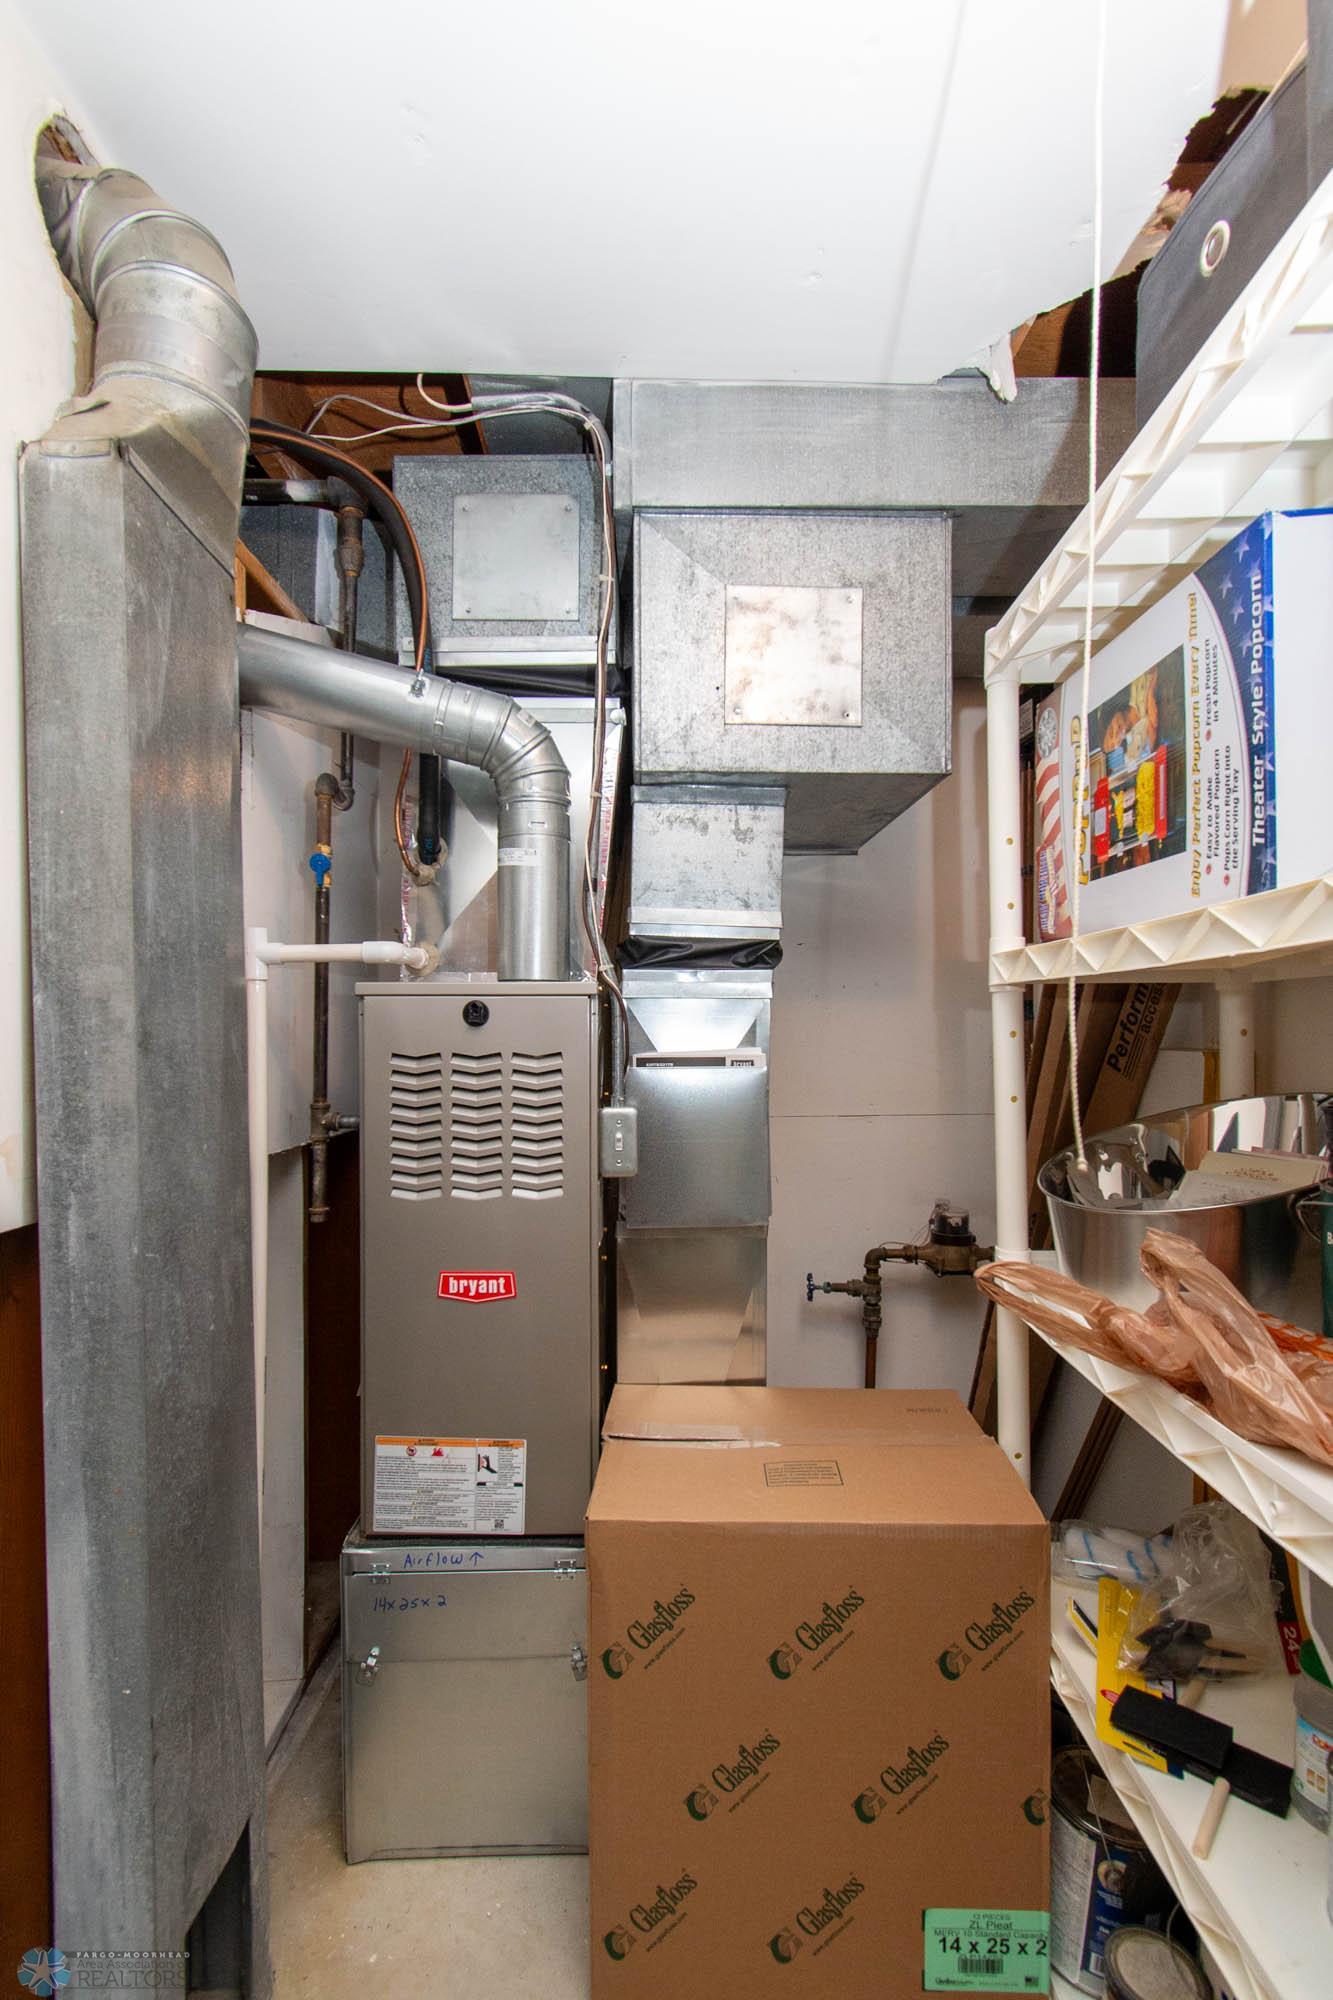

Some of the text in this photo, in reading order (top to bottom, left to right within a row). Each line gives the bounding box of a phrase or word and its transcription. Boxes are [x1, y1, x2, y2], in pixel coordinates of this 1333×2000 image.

[1189, 645, 1200, 697] Every
[1191, 700, 1202, 775] Popcorn
[1251, 573, 1266, 847] Theater Style Popcorn
[1205, 777, 1213, 810] Make
[1213, 749, 1221, 857] Flavored Popcorn
[1224, 776, 1232, 807] Right
[1232, 768, 1240, 794] Tray
[1191, 778, 1201, 846] Perfect
[1232, 796, 1240, 847] Serving
[1206, 833, 1214, 859] Easy
[1223, 842, 1231, 871] Pops
[448, 1276, 506, 1297] bryant
[403, 1552, 464, 1569] Airflow
[627, 1587, 697, 1652] Glasfloss
[795, 1588, 866, 1652] Glasfloss
[964, 1588, 1036, 1653] Glasfloss
[712, 1731, 782, 1794] Glasfloss
[880, 1733, 950, 1796] Glasfloss
[630, 1873, 698, 1935] Glasfloss
[796, 1876, 866, 1938] Glasfloss
[986, 1920, 1013, 1930] Pleat
[938, 1937, 1048, 1956] 14 x 25 x 2
